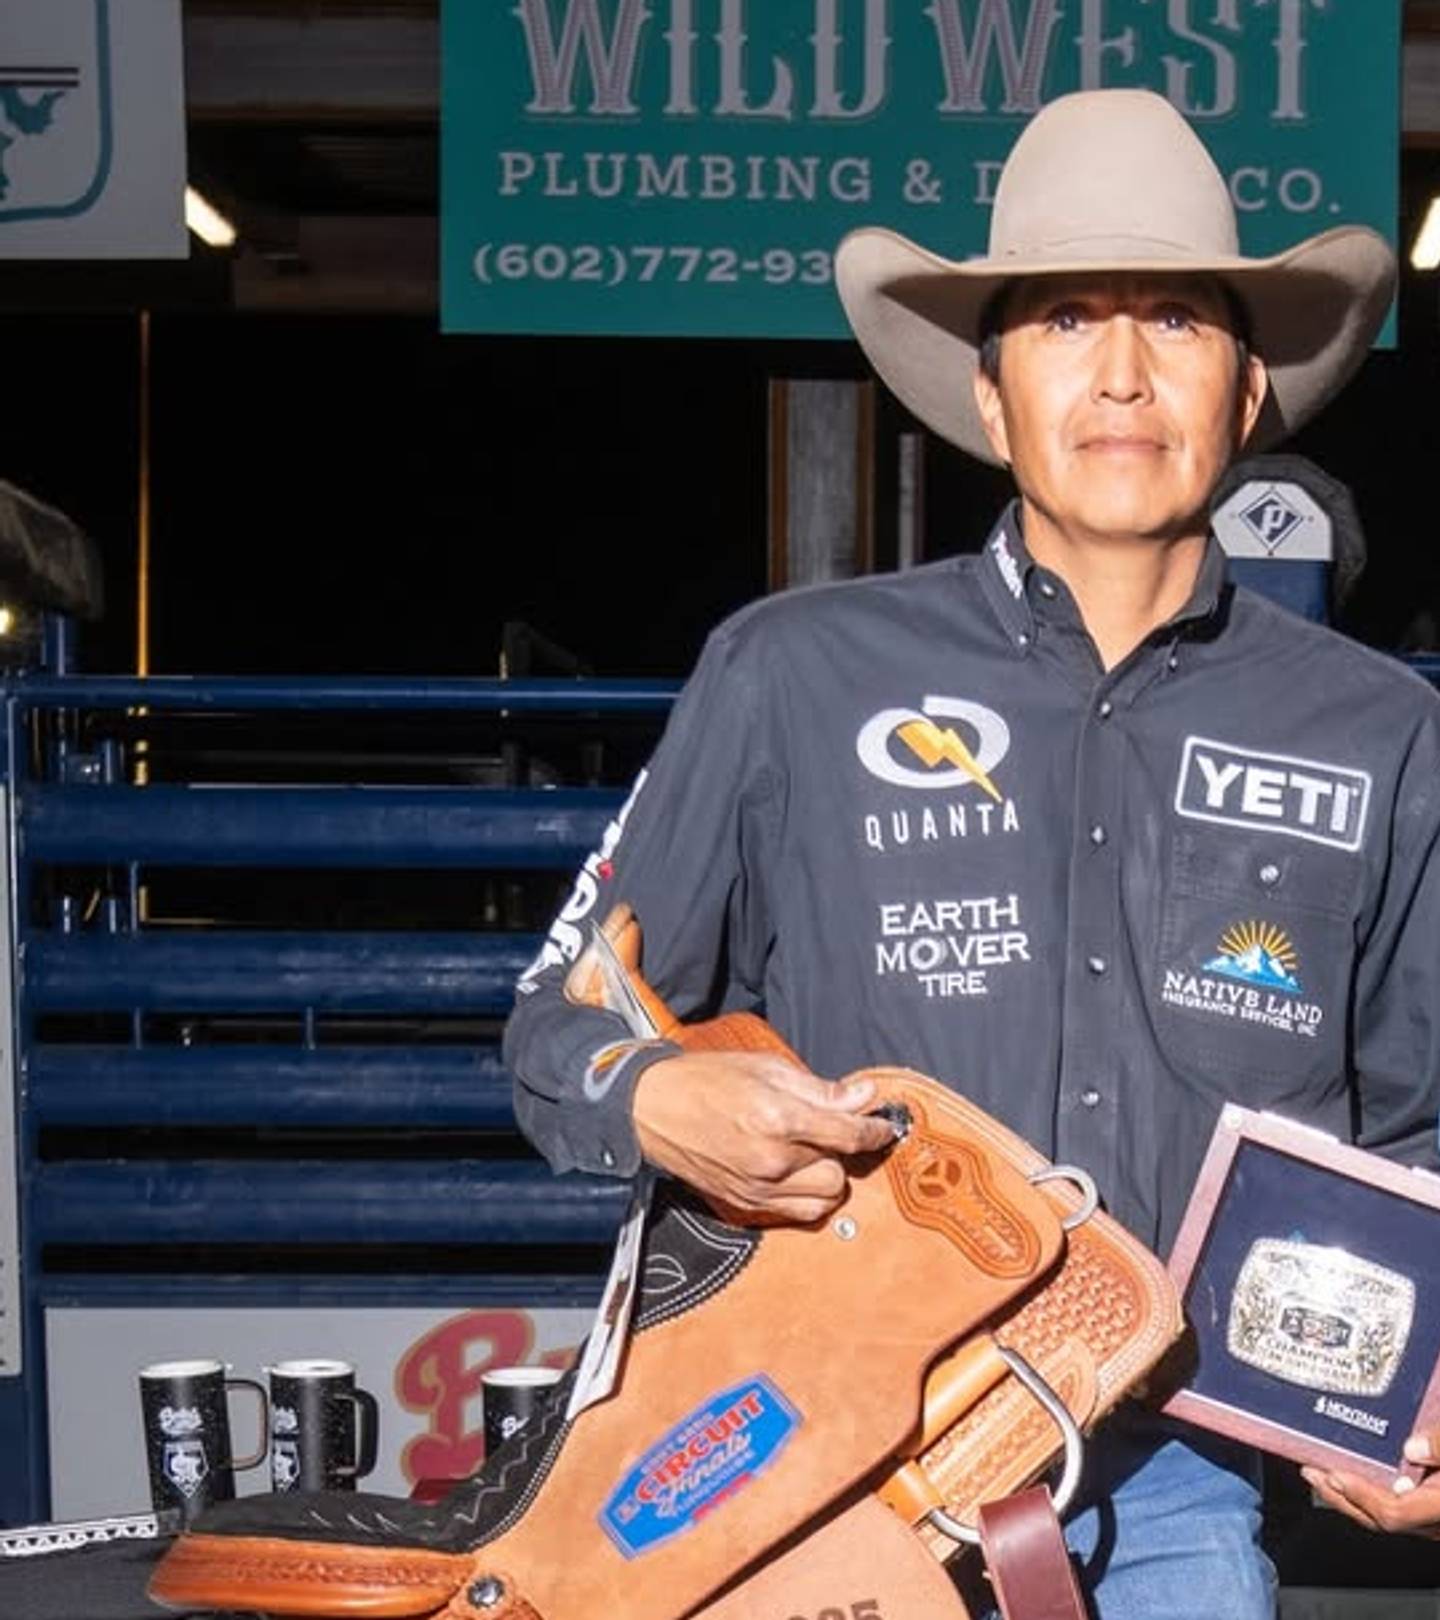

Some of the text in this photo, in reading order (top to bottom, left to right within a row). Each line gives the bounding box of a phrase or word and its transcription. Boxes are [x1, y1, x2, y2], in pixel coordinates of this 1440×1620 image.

[512, 0, 892, 119] WILD
[499, 152, 872, 202] PLUMBING
[903, 158, 941, 203] &
[1230, 167, 1341, 213] CO.
[473, 243, 836, 286] (602)772-93
[1197, 753, 1352, 833] YETI
[865, 800, 1020, 851] QUANTA
[880, 895, 1020, 936] EARTH
[876, 932, 1031, 975] MOVER
[918, 970, 988, 998] TIRE
[1163, 970, 1323, 1025] NATIVE LAND
[636, 1391, 765, 1504] CIRCUIT
[655, 1433, 753, 1519] Finals
